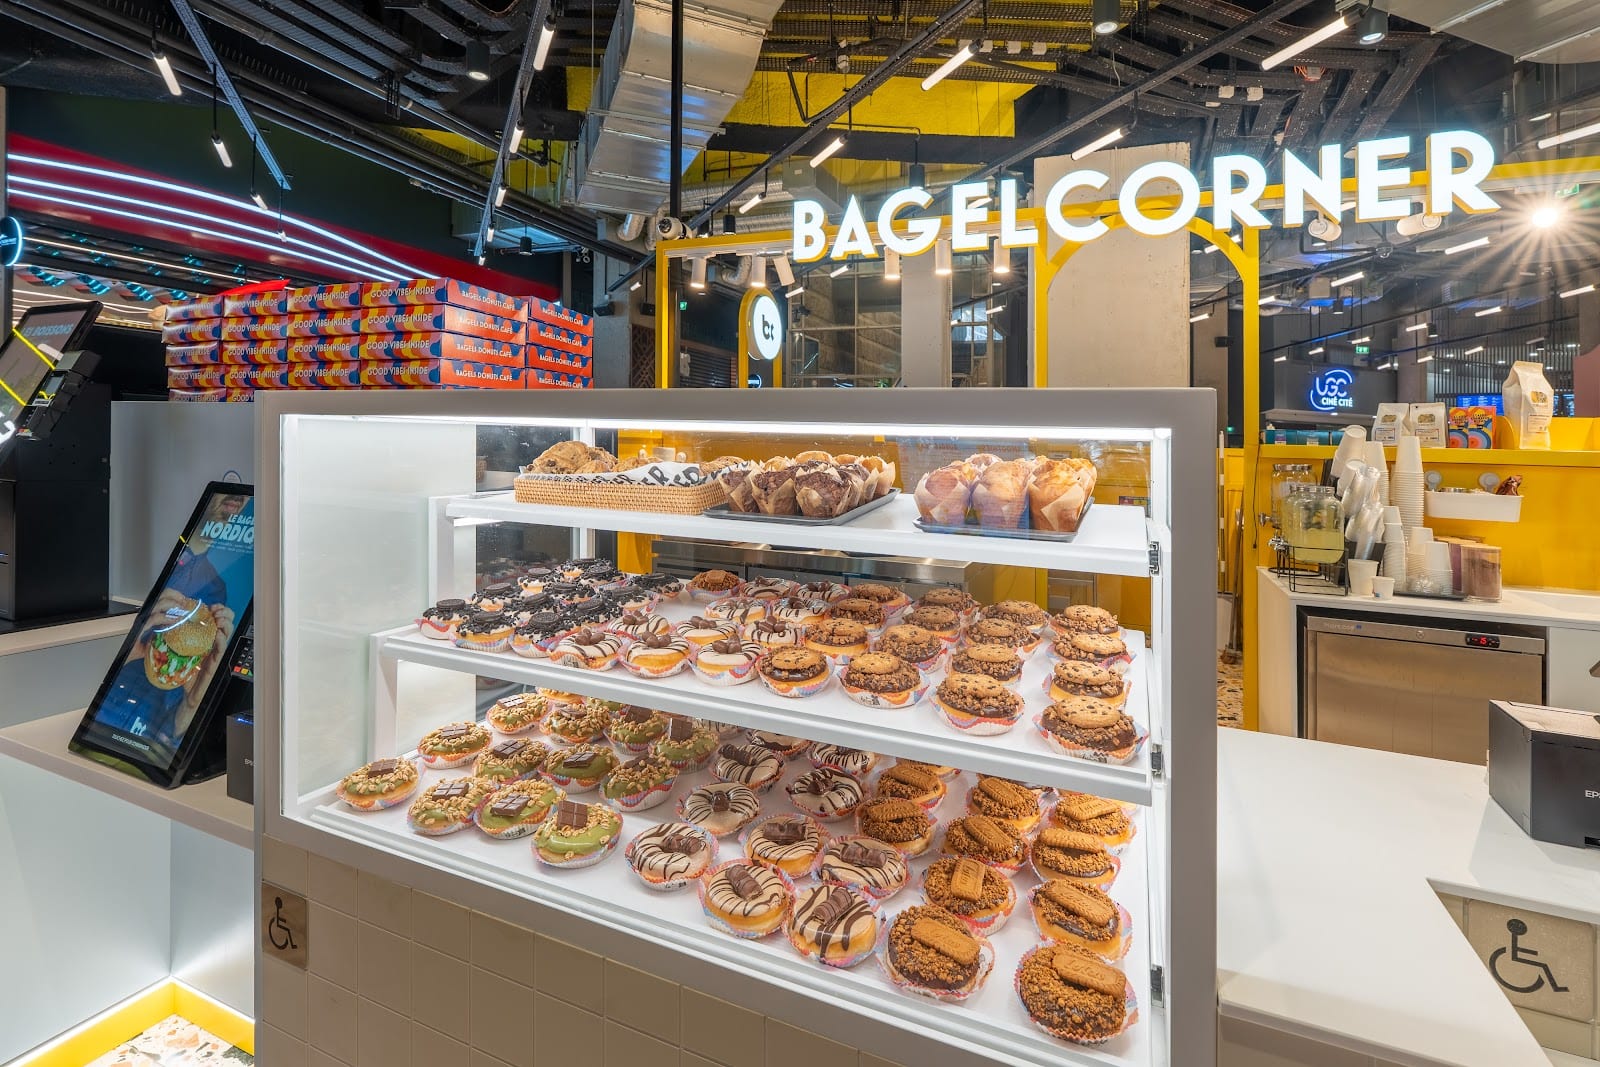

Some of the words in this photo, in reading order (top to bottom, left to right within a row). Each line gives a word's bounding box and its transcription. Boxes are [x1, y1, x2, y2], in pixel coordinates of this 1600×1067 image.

[371, 288, 392, 298] GOOD
[394, 287, 412, 296] VIBES
[415, 286, 434, 294] INSIDE
[294, 295, 312, 303] GOOD
[368, 314, 390, 324] GOOD
[392, 314, 408, 323] VIBES
[411, 313, 432, 322] INSIDE
[294, 320, 312, 328] GOOD
[294, 344, 312, 352] GOOD
[366, 340, 388, 350] GOOD
[390, 340, 406, 349] VIBES
[409, 340, 430, 348] INSIDE
[294, 370, 312, 378] GOOD
[368, 366, 388, 376] GOOD
[390, 366, 406, 376] VIBES
[408, 366, 428, 375] INSIDE
[456, 370, 476, 378] BAGELS
[1316, 377, 1348, 397] UGC
[1321, 396, 1338, 406] CINÉ
[1338, 398, 1353, 408] CITÉ
[228, 514, 238, 522] LE
